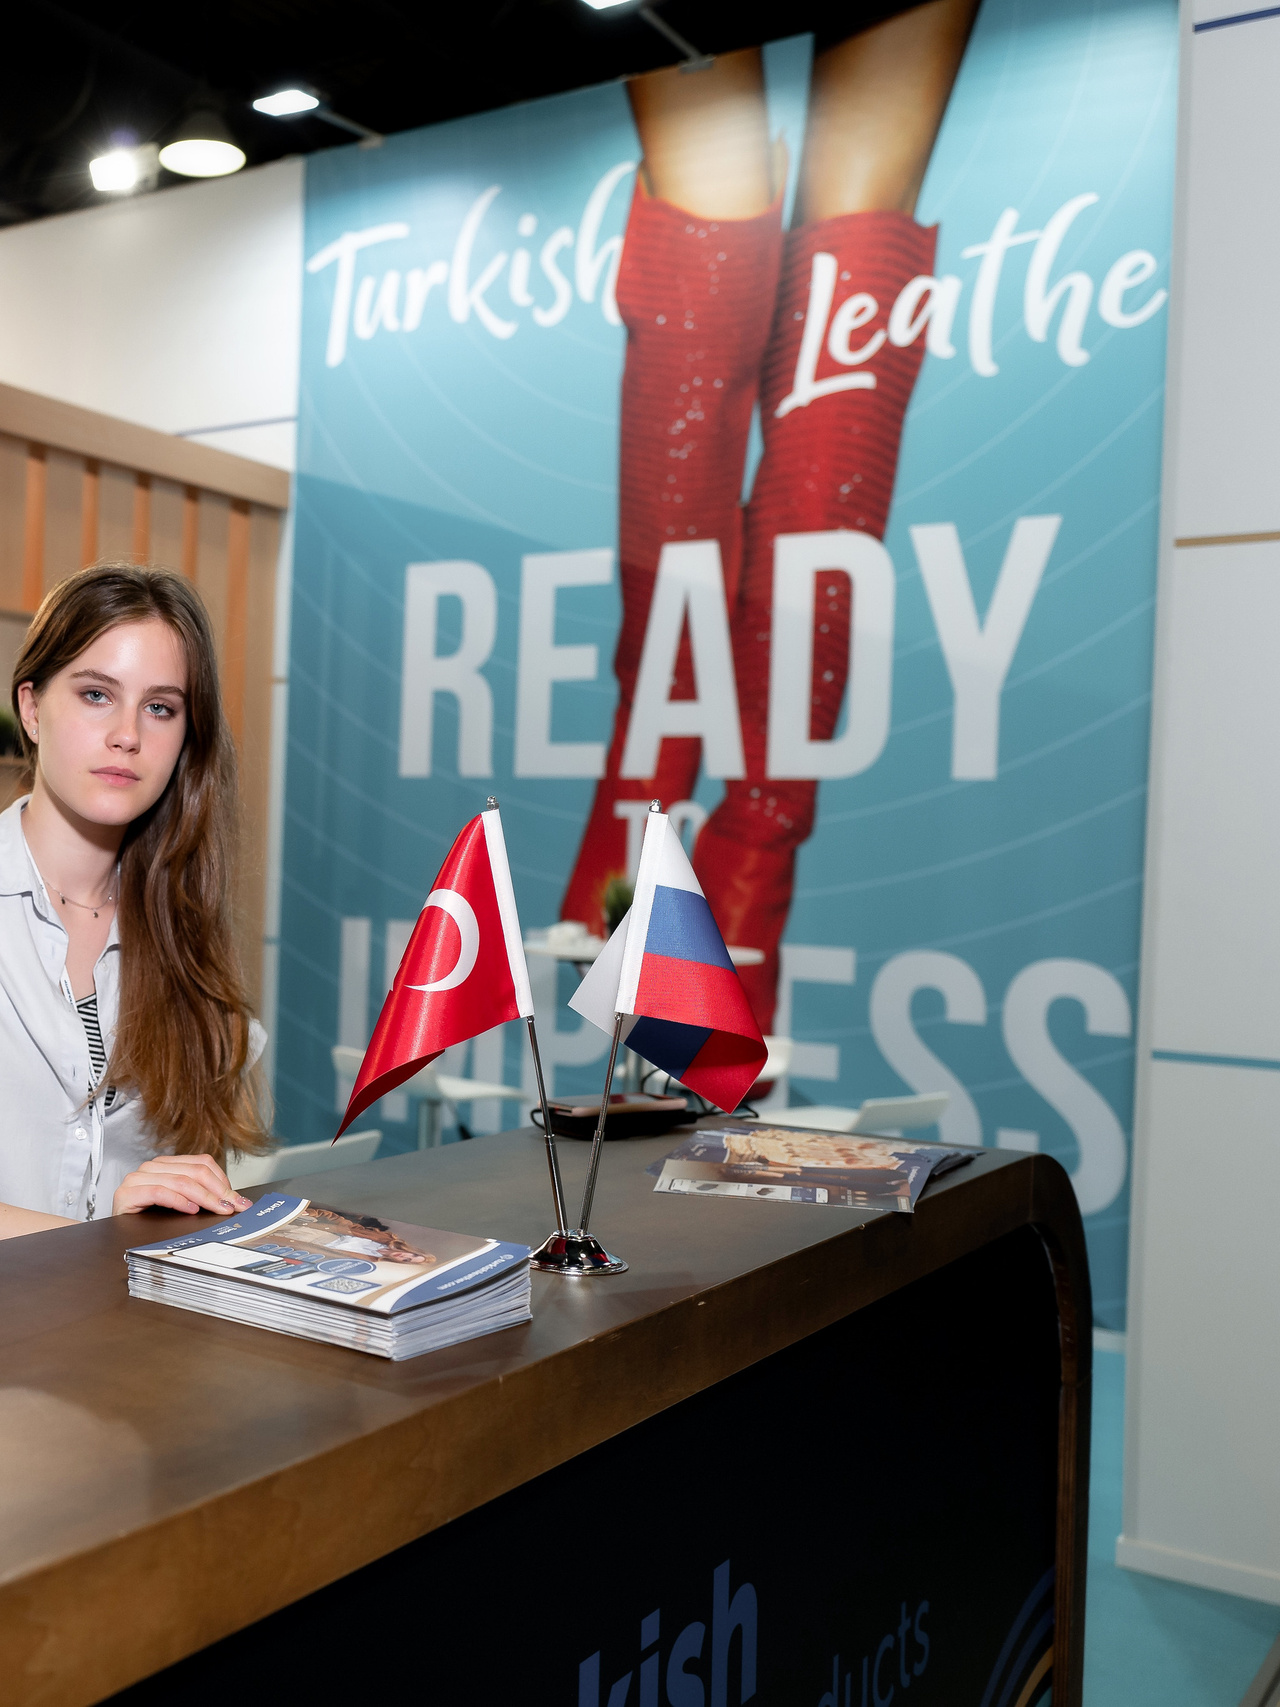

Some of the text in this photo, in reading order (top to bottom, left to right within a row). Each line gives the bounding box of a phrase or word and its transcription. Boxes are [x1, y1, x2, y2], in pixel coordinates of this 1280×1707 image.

[306, 161, 1168, 417] Turkish Leathe
[398, 514, 1062, 781] READY
